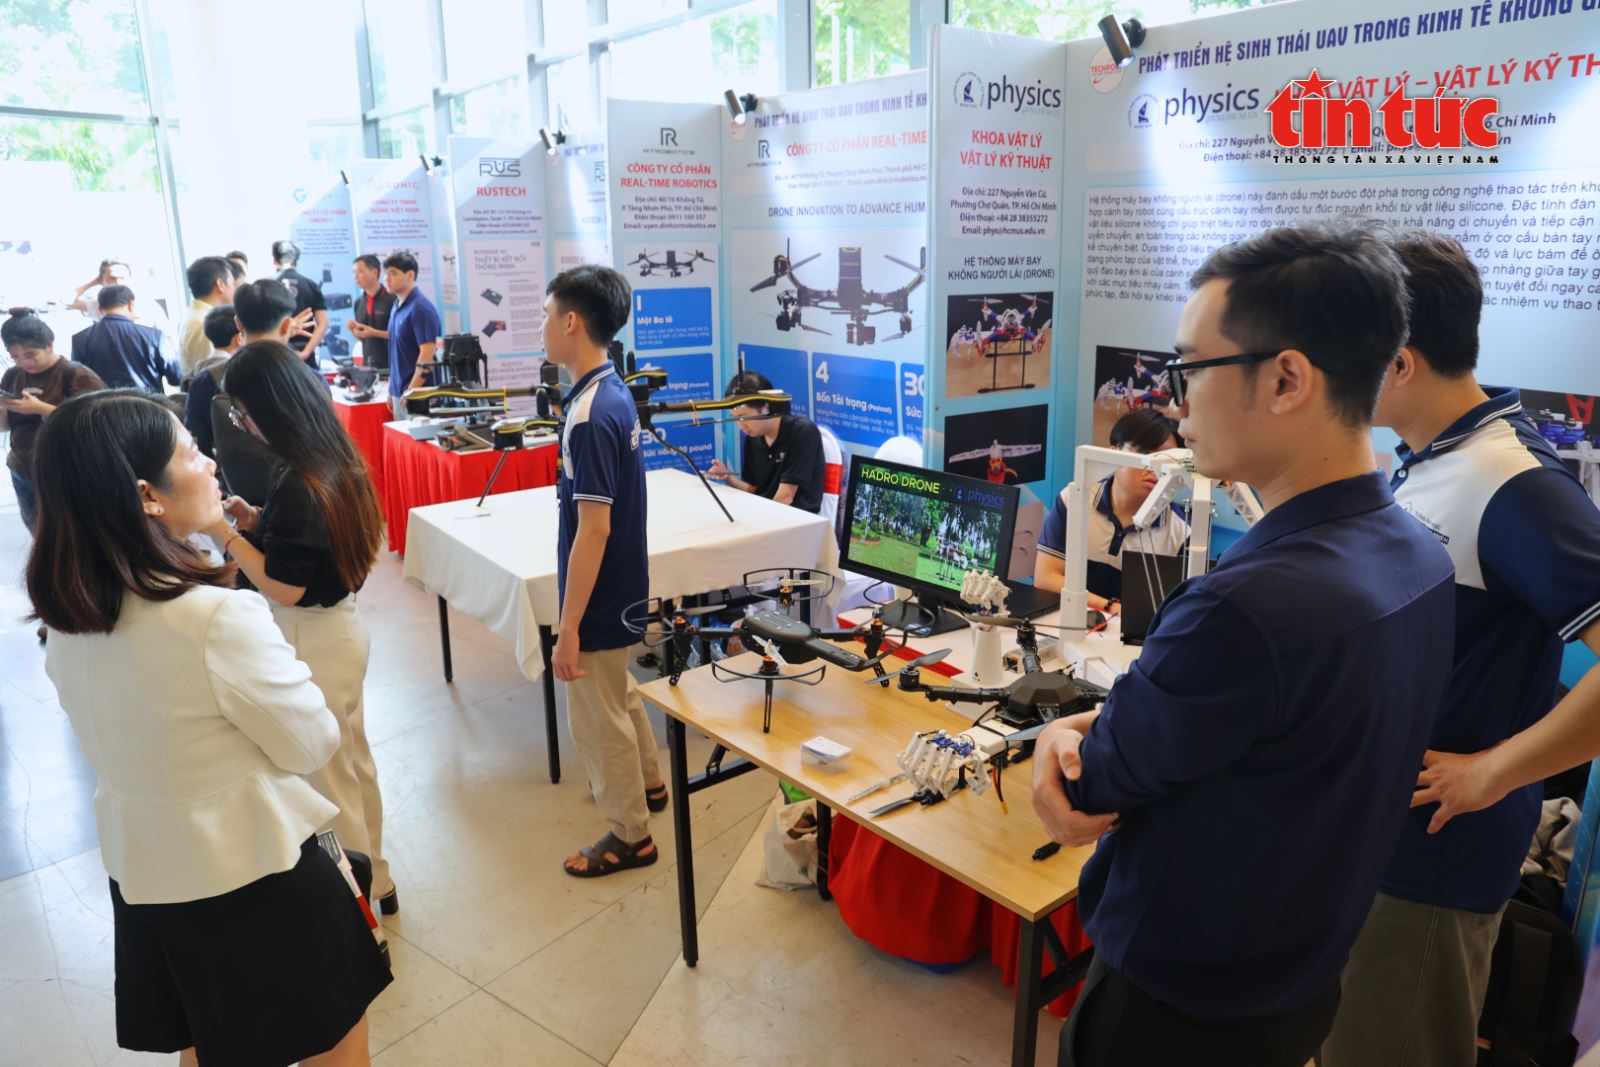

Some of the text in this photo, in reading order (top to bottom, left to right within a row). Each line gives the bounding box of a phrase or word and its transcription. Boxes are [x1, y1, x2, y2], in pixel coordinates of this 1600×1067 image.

[1139, 52, 1170, 74] PHÁT
[1174, 41, 1210, 70] TRIỂN
[1215, 41, 1232, 66] HỆ
[1237, 37, 1270, 59] SINH
[1277, 30, 1311, 55] THÁI
[1316, 26, 1348, 51] UAV
[1354, 16, 1410, 44] TRONG
[1417, 9, 1463, 35] KINH
[1434, 64, 1482, 95] VẬT
[1487, 58, 1519, 86] LÝ
[1523, 52, 1562, 82] KỸ
[988, 75, 1061, 112] physics
[882, 96, 902, 111] KINH
[1165, 83, 1259, 125] physics
[1497, 113, 1556, 128] Chí Minh
[972, 130, 1042, 150] KHOA VẬT LÝ
[1212, 139, 1227, 147] 227
[787, 142, 812, 157] CÔNG
[1203, 153, 1223, 162] Điện
[1225, 152, 1252, 162] thoại:
[1254, 150, 1271, 160] +84
[628, 163, 655, 173] CÔNG
[658, 165, 668, 173] TY
[961, 149, 1052, 173] VẬT LÝ KỸ THUẬT
[621, 178, 717, 188] REAL-TIME ROBOTICS
[477, 187, 527, 196] RUSTECH
[962, 187, 973, 197] Địa
[1000, 188, 1024, 198] Nguyễn
[1139, 183, 1576, 204] bay (drone) một bước đột trong công nghệ thao tác trên
[769, 202, 925, 217] DRONE INNOVATION TO ADVANCE HUM
[951, 200, 976, 210] Phường
[1233, 206, 1247, 215] bay
[1275, 204, 1299, 214] được
[1336, 204, 1372, 215] nguyên
[1416, 202, 1432, 212] vật
[1435, 202, 1455, 211] liệu
[1459, 201, 1506, 211] silicone.
[1512, 200, 1537, 210] Đặc
[1541, 199, 1565, 209] tính
[1570, 199, 1595, 209] đàn
[960, 213, 975, 222] Điện
[1404, 214, 1594, 229] khả năng di chuyển và tiếp cận
[962, 226, 981, 234] Email:
[1484, 231, 1592, 245] ở cơ cấu bàn tay
[1475, 246, 1587, 260] độ lực bám để
[965, 256, 975, 269] HỆ
[1008, 255, 1024, 265] MÁY
[1027, 256, 1041, 265] BAY
[949, 269, 978, 280] KHÔNG
[1024, 269, 1055, 279] (DRONE)
[1493, 264, 1588, 279] nhàng giữa tay
[1496, 280, 1584, 294] tuyệt đối ngay
[1501, 298, 1591, 310] nhiệm vụ thao
[653, 316, 663, 324] Ba
[816, 361, 829, 383] 4
[669, 382, 688, 390] trọng
[816, 390, 830, 402] Bốn
[832, 392, 844, 404] Tải
[846, 395, 867, 412] trọng
[906, 405, 921, 418] Sức
[689, 443, 712, 453] pound
[861, 468, 940, 494] HADRO DRONE
[968, 490, 1004, 506] physics
